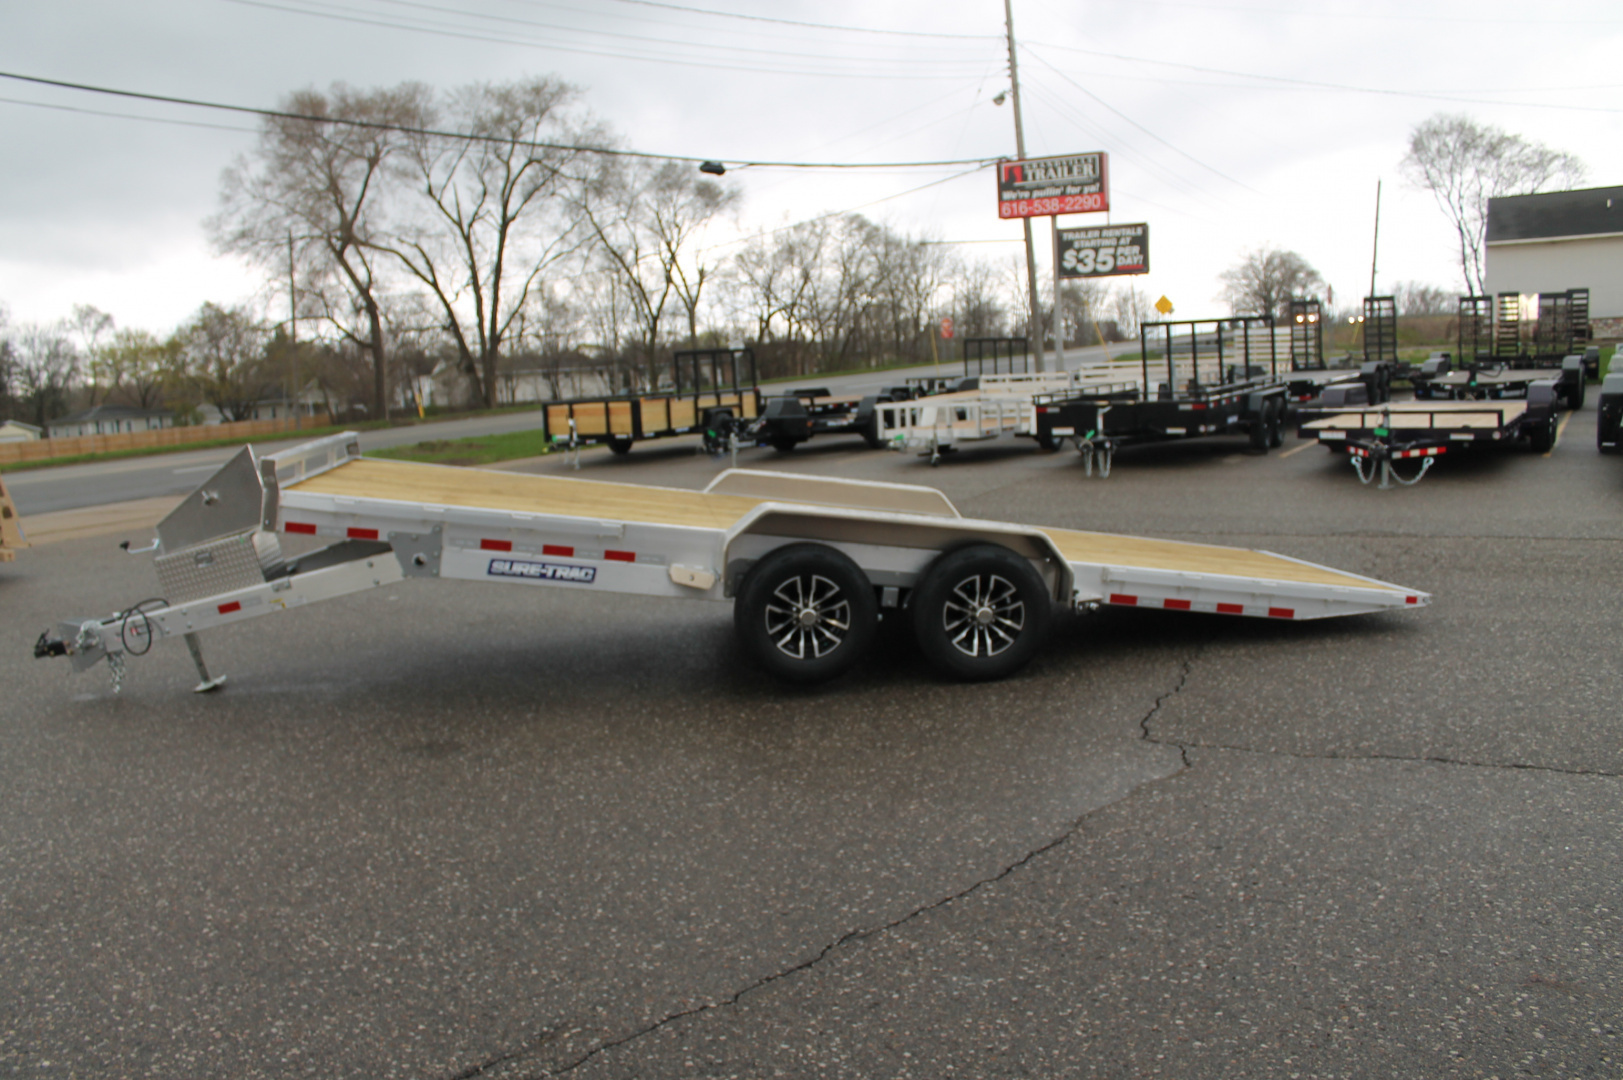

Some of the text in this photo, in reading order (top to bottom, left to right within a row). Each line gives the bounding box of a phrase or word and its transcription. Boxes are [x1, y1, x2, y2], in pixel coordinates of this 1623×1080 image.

[1027, 163, 1094, 182] TRAILER
[1002, 190, 1030, 201] We're
[1065, 185, 1082, 196] for
[1001, 195, 1101, 217] 616-538-2290
[1062, 226, 1143, 241] TRAILER RENTALS
[1073, 236, 1132, 249] STARTING AT
[1116, 245, 1140, 256] PER
[1062, 246, 1115, 274] $35
[490, 560, 594, 581] SURE-TRAC
